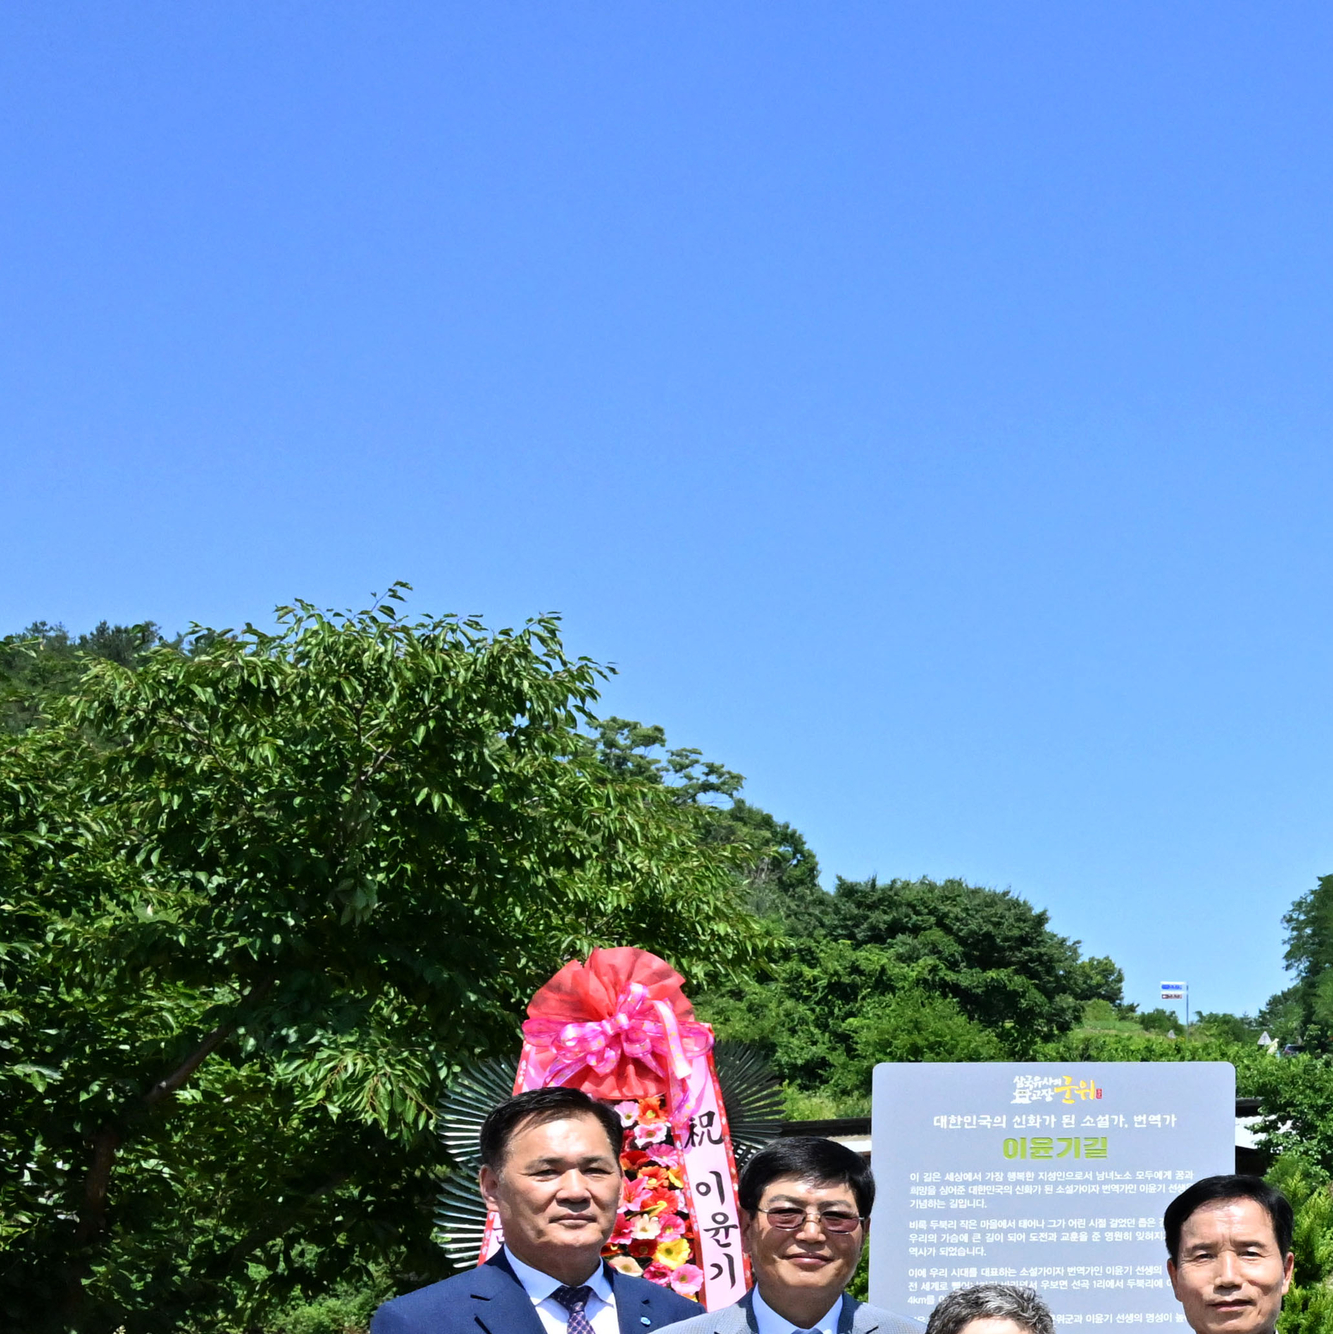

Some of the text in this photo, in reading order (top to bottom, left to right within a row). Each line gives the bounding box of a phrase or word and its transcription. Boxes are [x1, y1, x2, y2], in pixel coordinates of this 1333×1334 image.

[1054, 1075, 1096, 1104] 군위
[933, 1114, 1177, 1129] 대한민국의 신화가 된 소설가, 번역가
[1003, 1137, 1108, 1159] 이윤기길
[910, 1170, 1194, 1182] 이 길은 세상에서 가장 행복한 지성인으로서 남녀노소 모두에게 꿈과
[968, 1185, 1013, 1195] 대한민국의
[1015, 1185, 1042, 1195] 신화가
[1044, 1185, 1053, 1194] 된
[1056, 1184, 1100, 1194] 소설가이자
[1102, 1184, 1137, 1194] 번역가인
[1139, 1183, 1166, 1194] 이윤기
[684, 1110, 739, 1289] 祝 이윤기
[910, 1198, 987, 1209] 기념하는 길입니다.
[909, 1220, 927, 1230] 비록
[930, 1220, 957, 1230] 두북리
[959, 1219, 977, 1230] 작은
[980, 1219, 1016, 1230] 마을에서
[1018, 1219, 1045, 1229] 태어나
[1047, 1218, 1066, 1229] 그가
[1068, 1218, 1086, 1229] 어린
[1088, 1218, 1106, 1228] 시절
[1109, 1218, 1136, 1228] 걸었던
[909, 1231, 1132, 1243] 우리의 가슴에 큰 길이 되어 도전과 교훈을 준 영원히
[909, 1246, 986, 1257] 역사가 되었습니다.
[908, 1265, 1163, 1278] 이에 우리 시대를 대표하는 소설가이자 번역가인 이윤기 선생의
[908, 1281, 918, 1291] 전
[920, 1281, 948, 1291] 세계로
[1040, 1280, 1068, 1290] 우보면
[1071, 1279, 1090, 1289] 선곡
[1093, 1279, 1124, 1289] 1리에서
[1126, 1278, 1164, 1289] 두북리에
[1086, 1313, 1172, 1324] 이윤기 선생의 명성이
